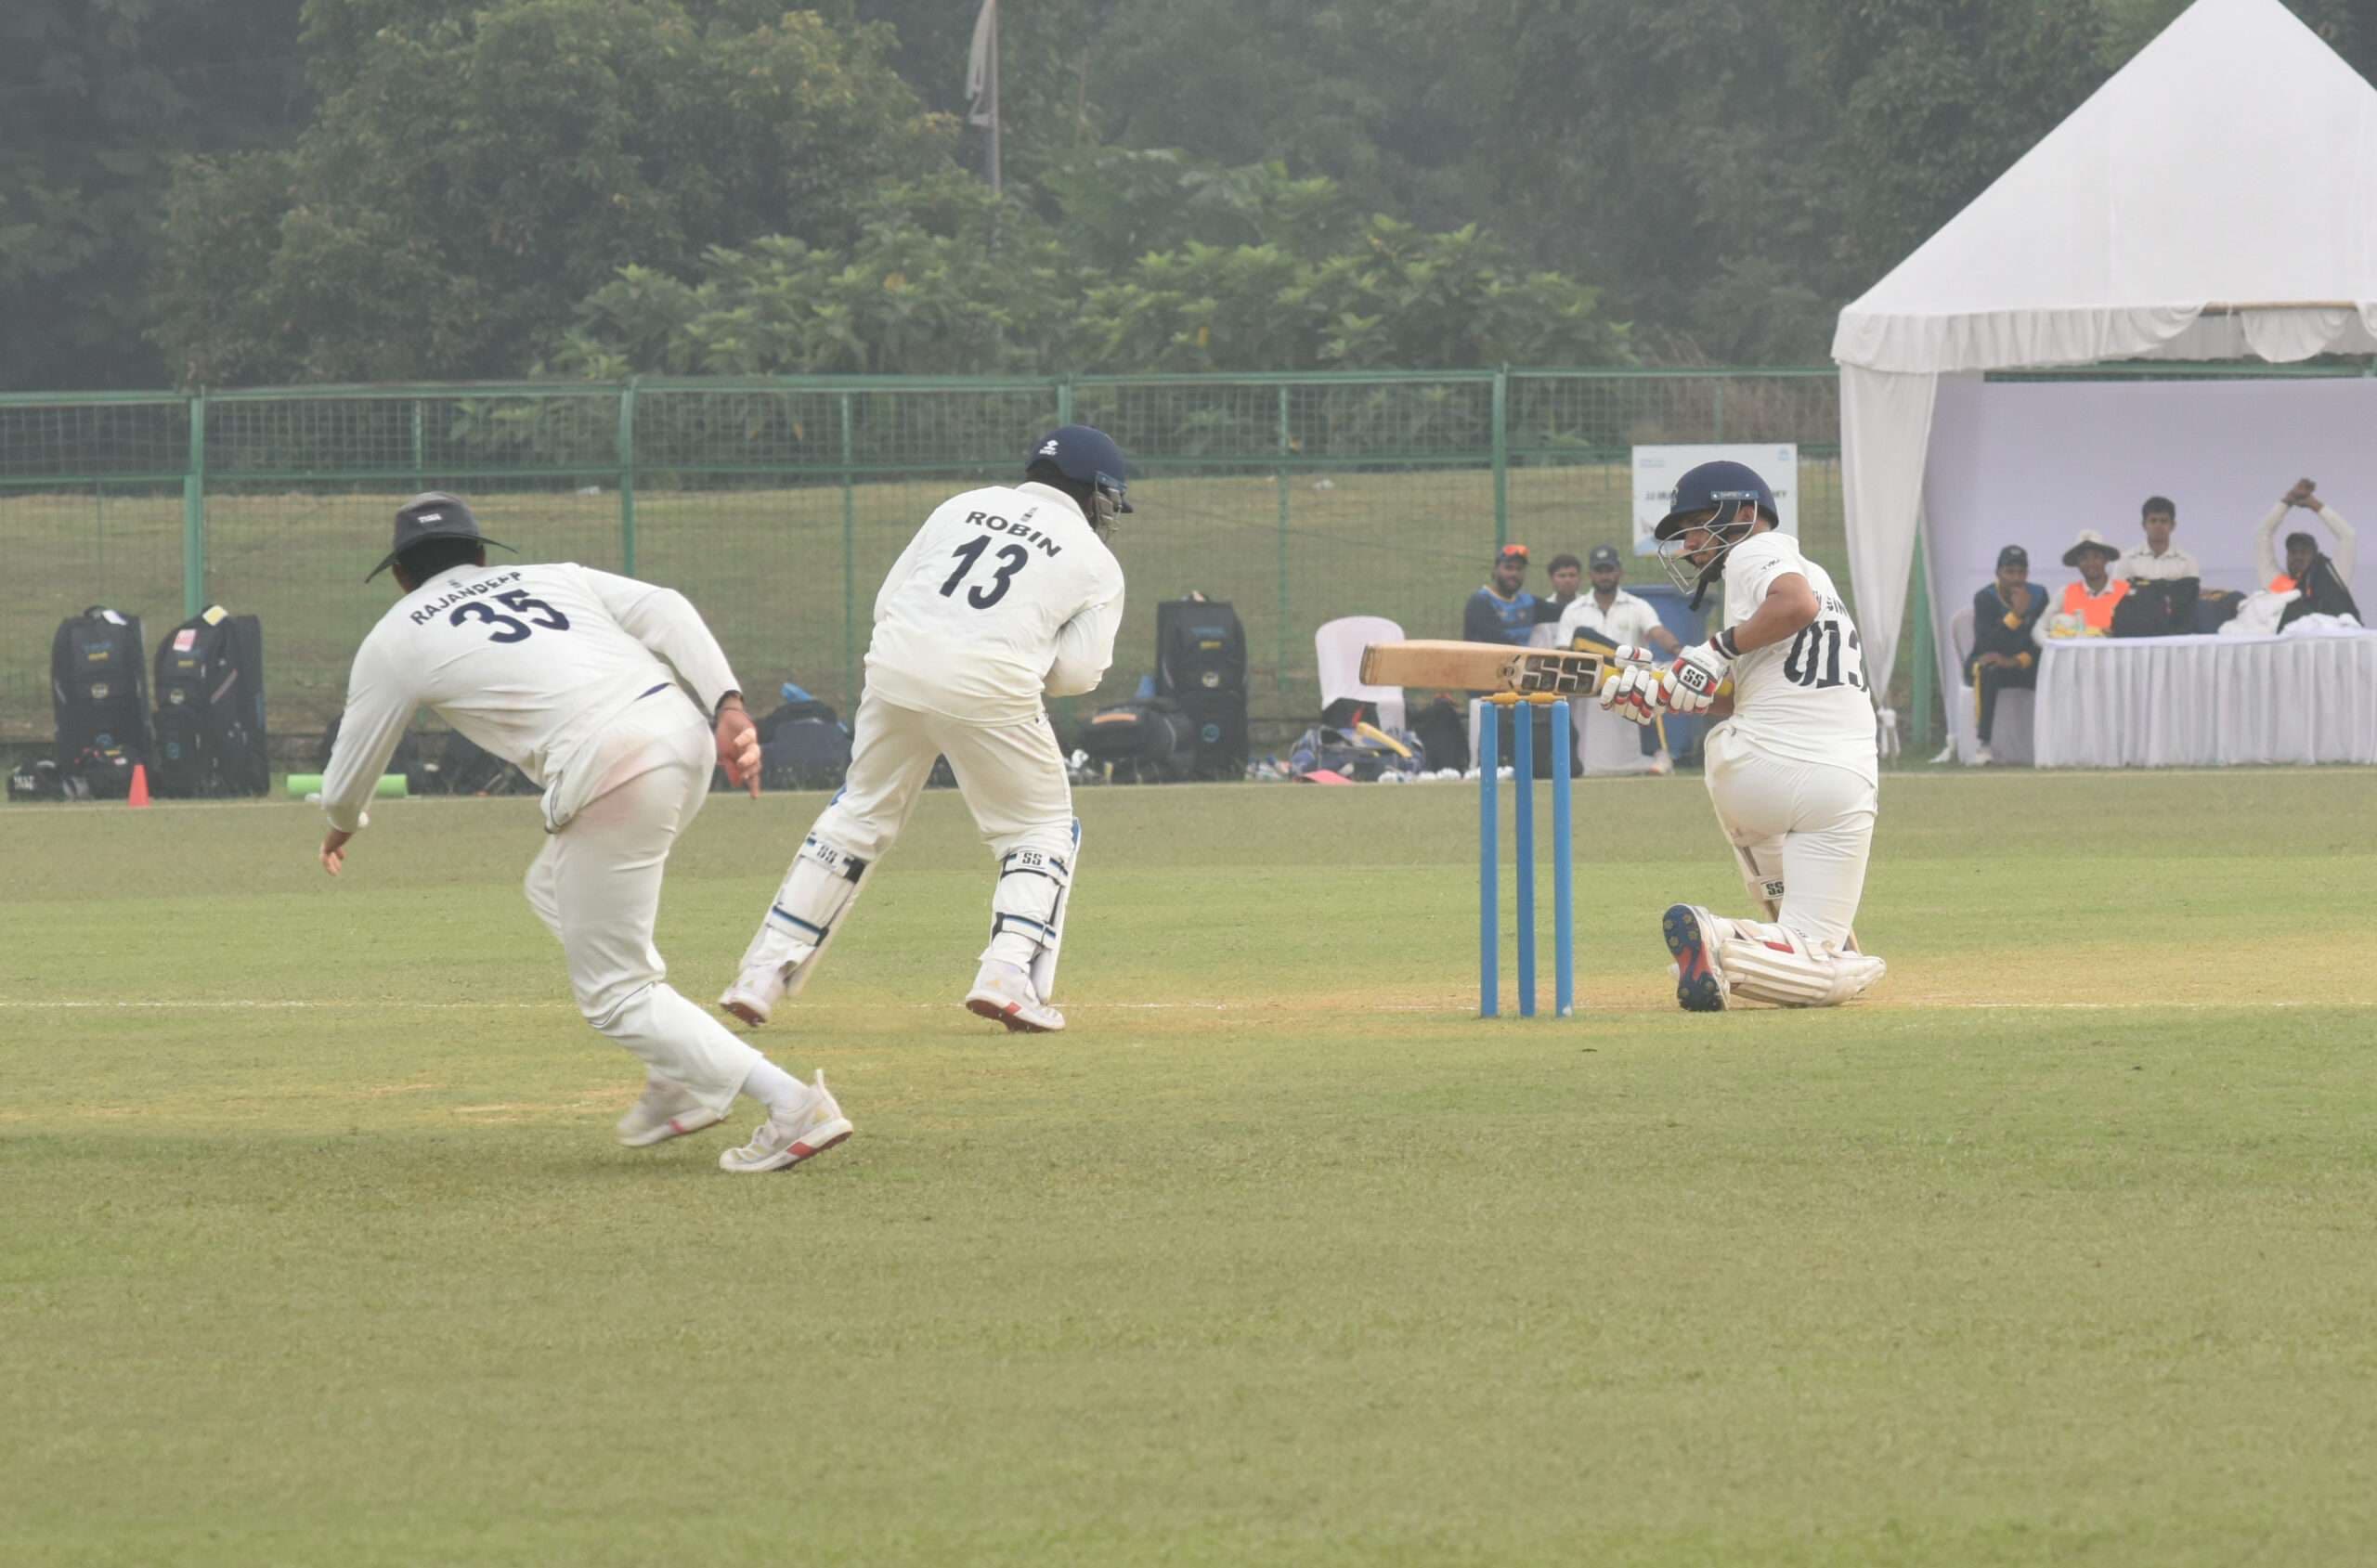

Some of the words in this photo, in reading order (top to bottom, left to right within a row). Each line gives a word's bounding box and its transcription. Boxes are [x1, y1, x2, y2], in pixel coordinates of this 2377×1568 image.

[966, 511, 1062, 558] ROBIN
[939, 534, 1028, 609] 13
[449, 589, 570, 643] 35
[1521, 654, 1597, 694] SS
[1682, 667, 1705, 687] SS
[1022, 852, 1043, 866] SS
[1766, 881, 1785, 896] SS
